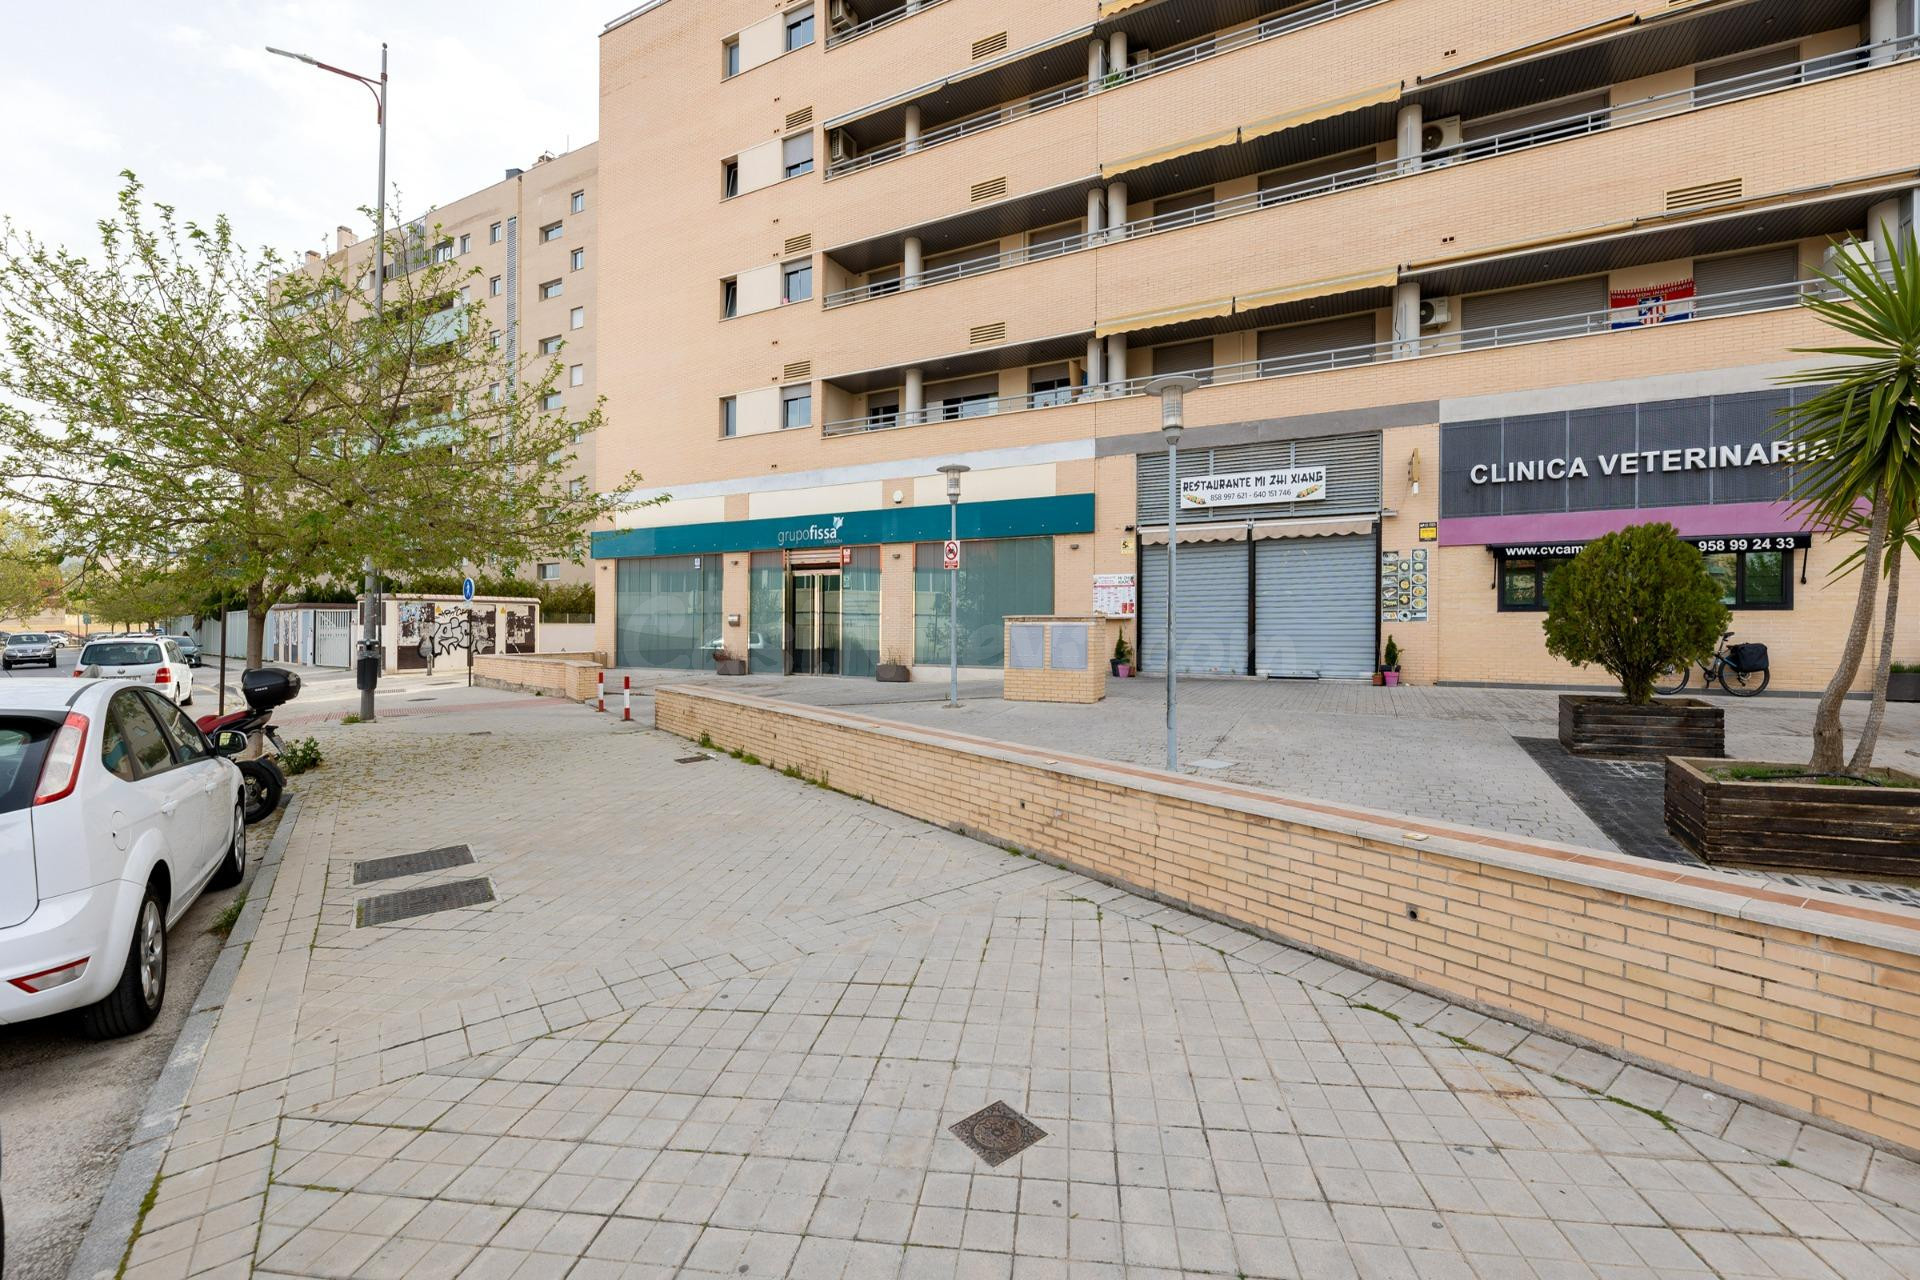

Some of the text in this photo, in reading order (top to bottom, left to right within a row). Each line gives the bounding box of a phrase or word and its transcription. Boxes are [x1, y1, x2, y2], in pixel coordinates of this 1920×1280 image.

[1470, 456, 1589, 484] CLINICA
[1183, 471, 1323, 492] RESTAURANTE MI ZHI XIANG
[1210, 493, 1222, 502] 858
[1223, 492, 1235, 500] 997
[1253, 490, 1266, 499] 640
[1279, 489, 1292, 497] 746
[1698, 537, 1795, 552] 958 99 24 33
